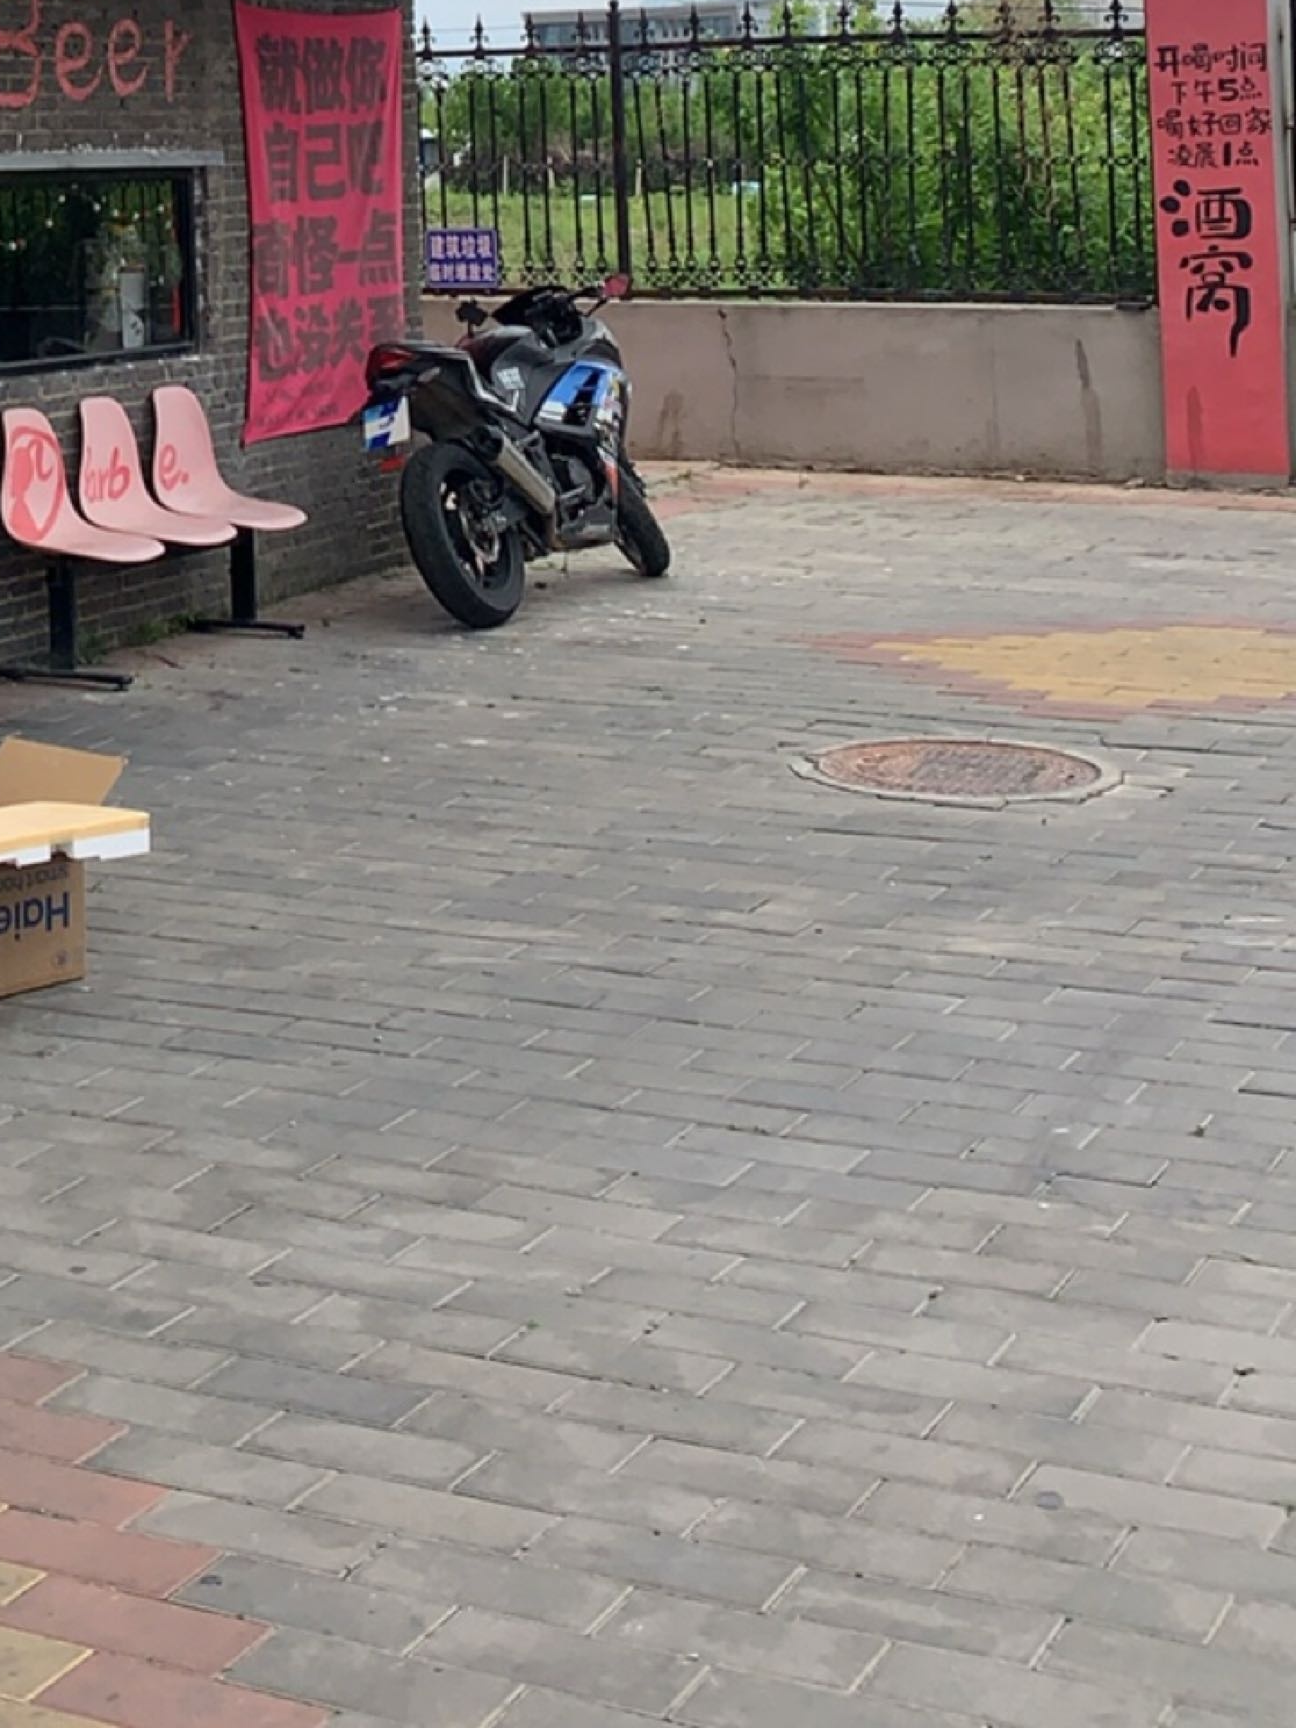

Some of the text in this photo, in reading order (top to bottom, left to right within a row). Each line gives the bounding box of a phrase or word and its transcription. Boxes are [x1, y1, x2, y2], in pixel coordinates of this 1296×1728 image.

[1154, 43, 1267, 77] 开喝时间
[1171, 75, 1262, 105] 下午5点
[1157, 106, 1272, 139] 喝好回家
[1168, 140, 1259, 169] 凌晨1点
[1160, 179, 1253, 359] 酒窝
